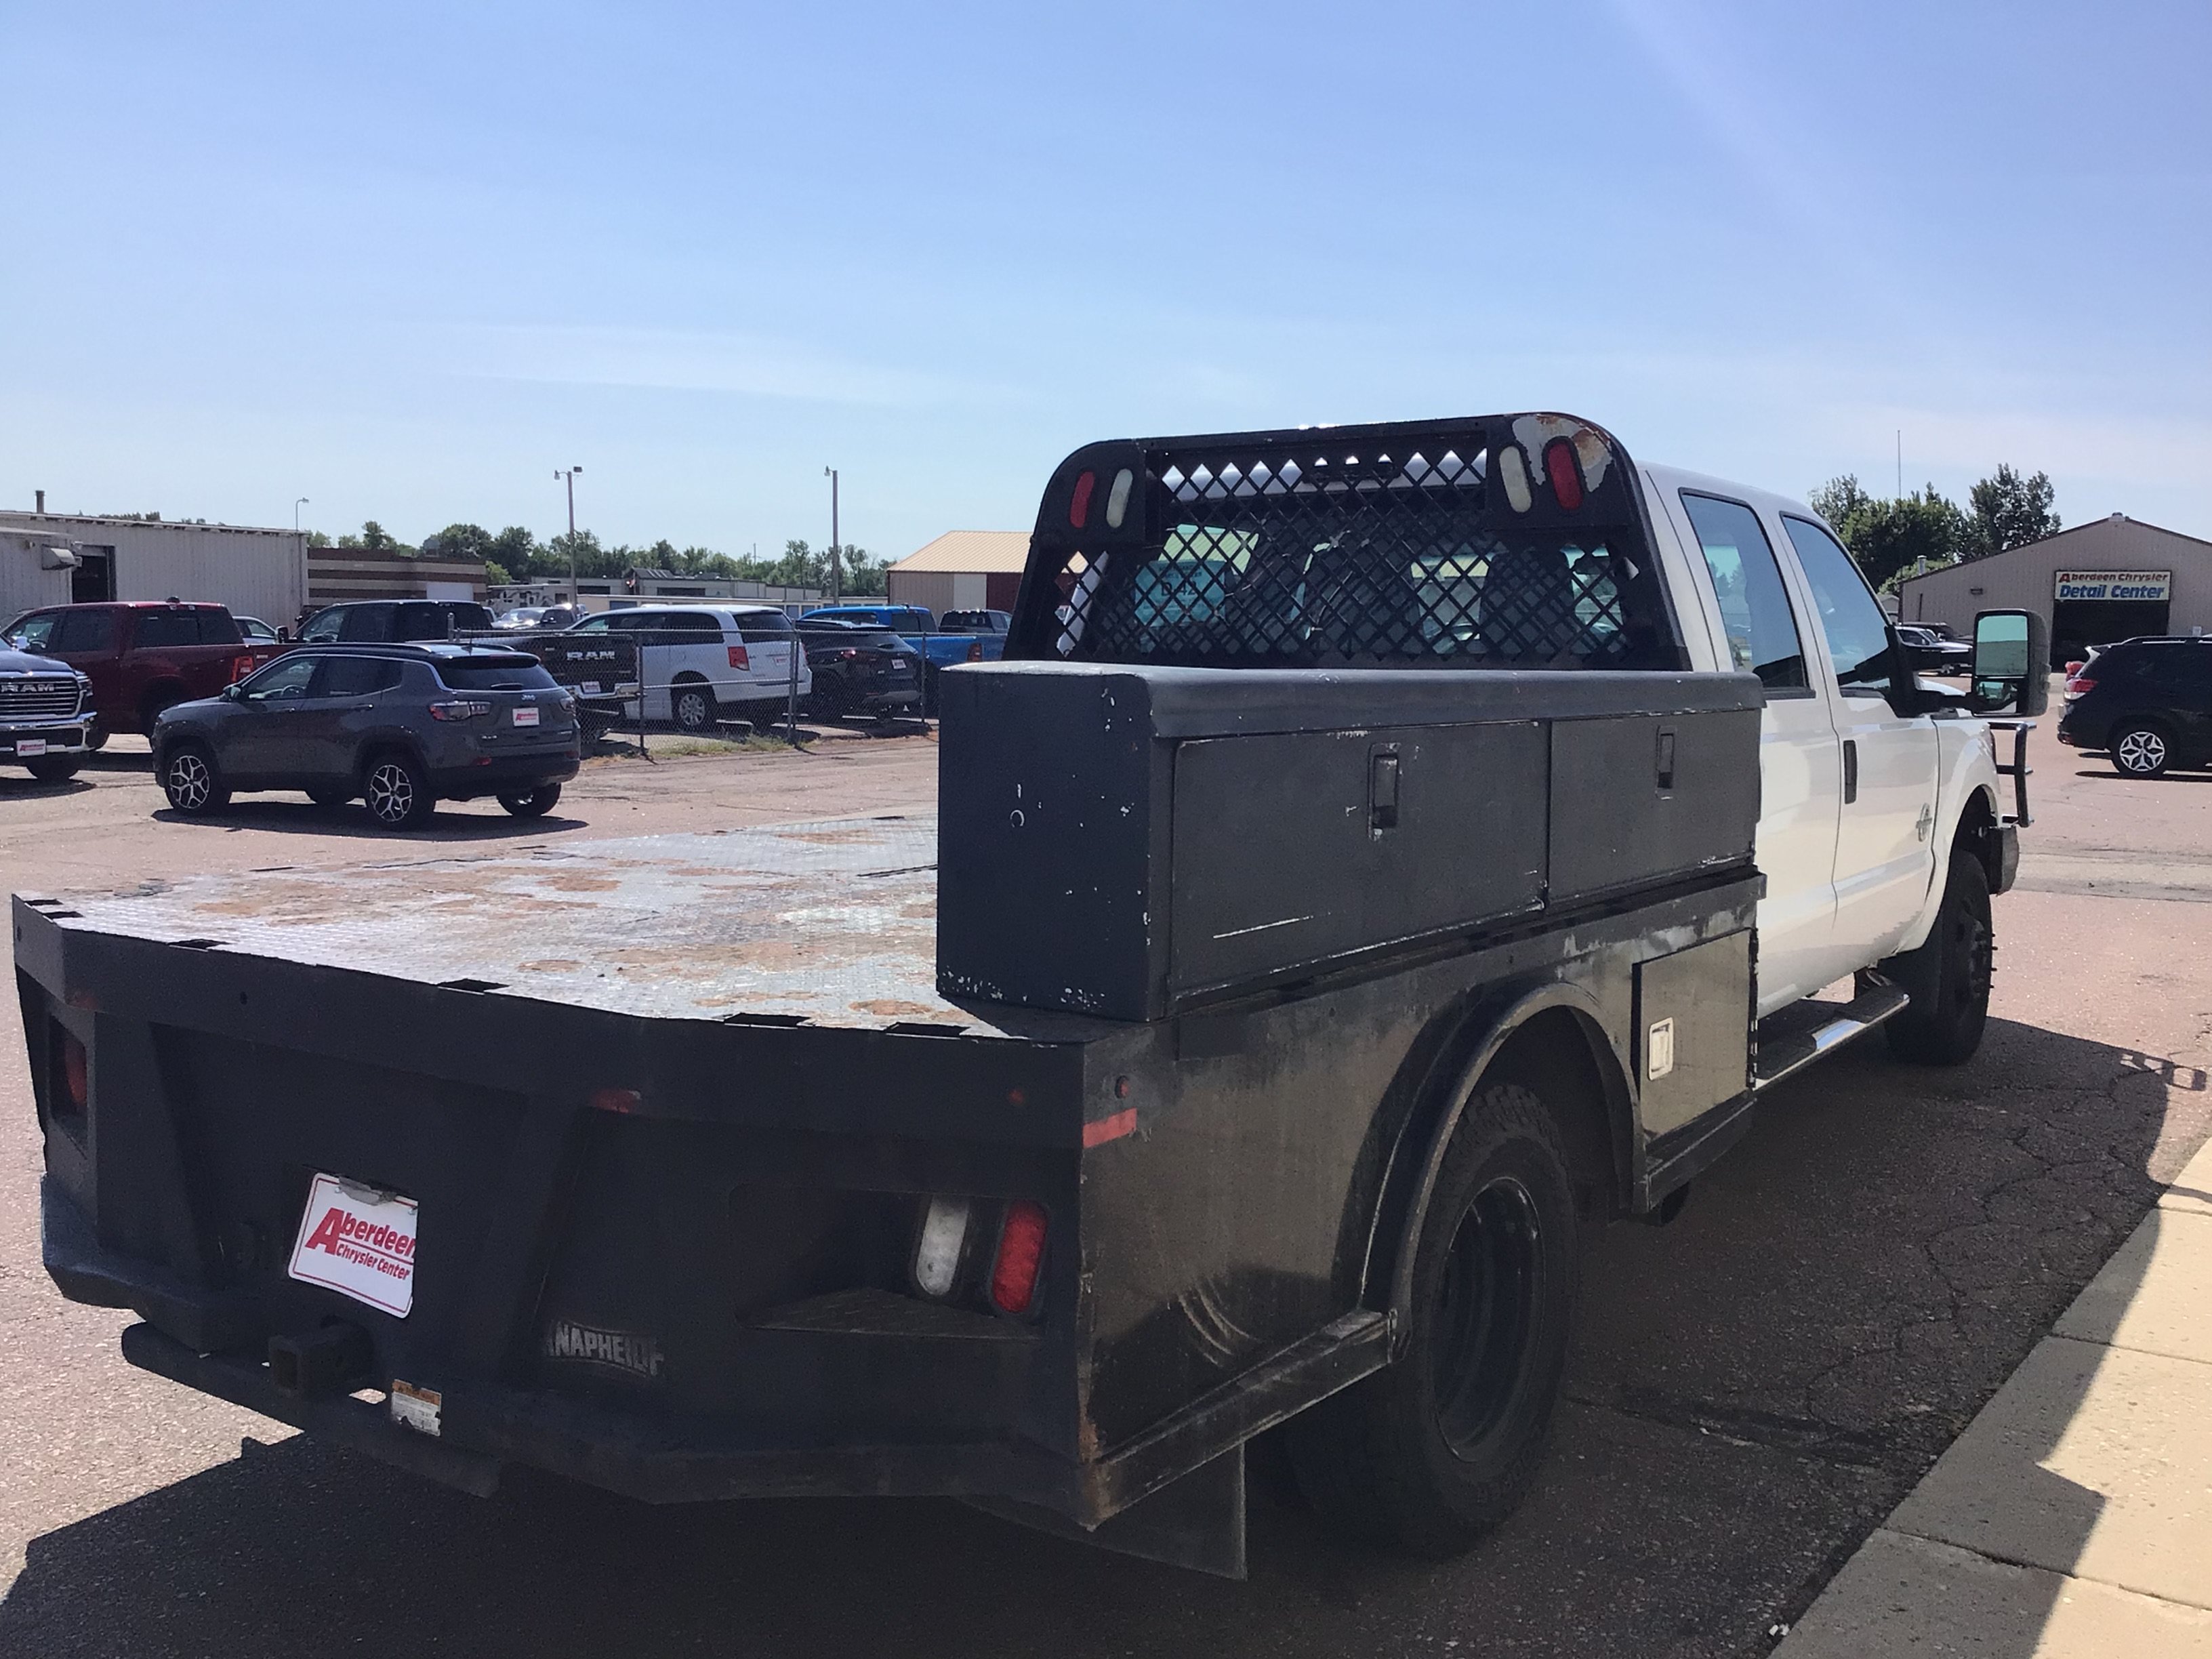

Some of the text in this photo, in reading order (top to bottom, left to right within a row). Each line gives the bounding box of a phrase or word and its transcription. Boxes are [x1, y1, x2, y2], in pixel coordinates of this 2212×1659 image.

[2059, 573, 2168, 583] Aberdeen Chrysler
[2060, 585, 2165, 598] Detail Center
[567, 651, 615, 661] RAM
[1, 684, 54, 692] RAM
[336, 1244, 410, 1280] Chrysler Center
